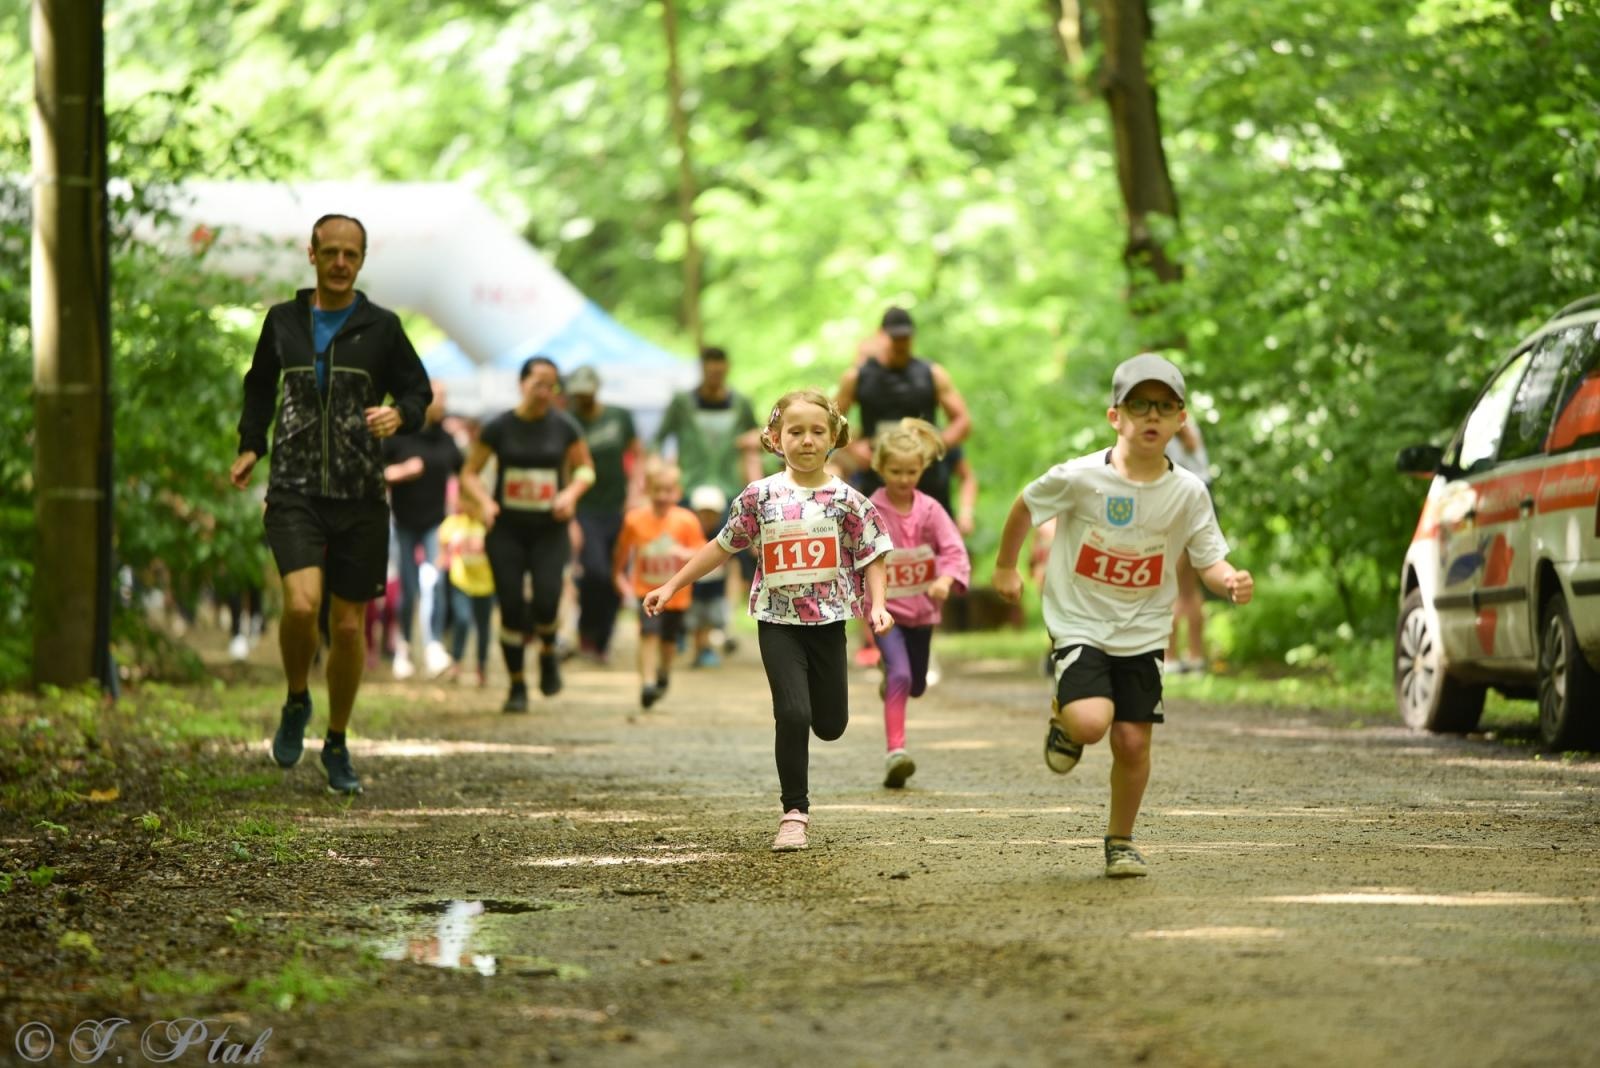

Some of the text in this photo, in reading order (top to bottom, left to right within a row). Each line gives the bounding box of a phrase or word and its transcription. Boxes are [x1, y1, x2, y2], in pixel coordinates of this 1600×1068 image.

[773, 540, 826, 571] 119
[1091, 555, 1152, 586] 156
[886, 562, 928, 587] 139
